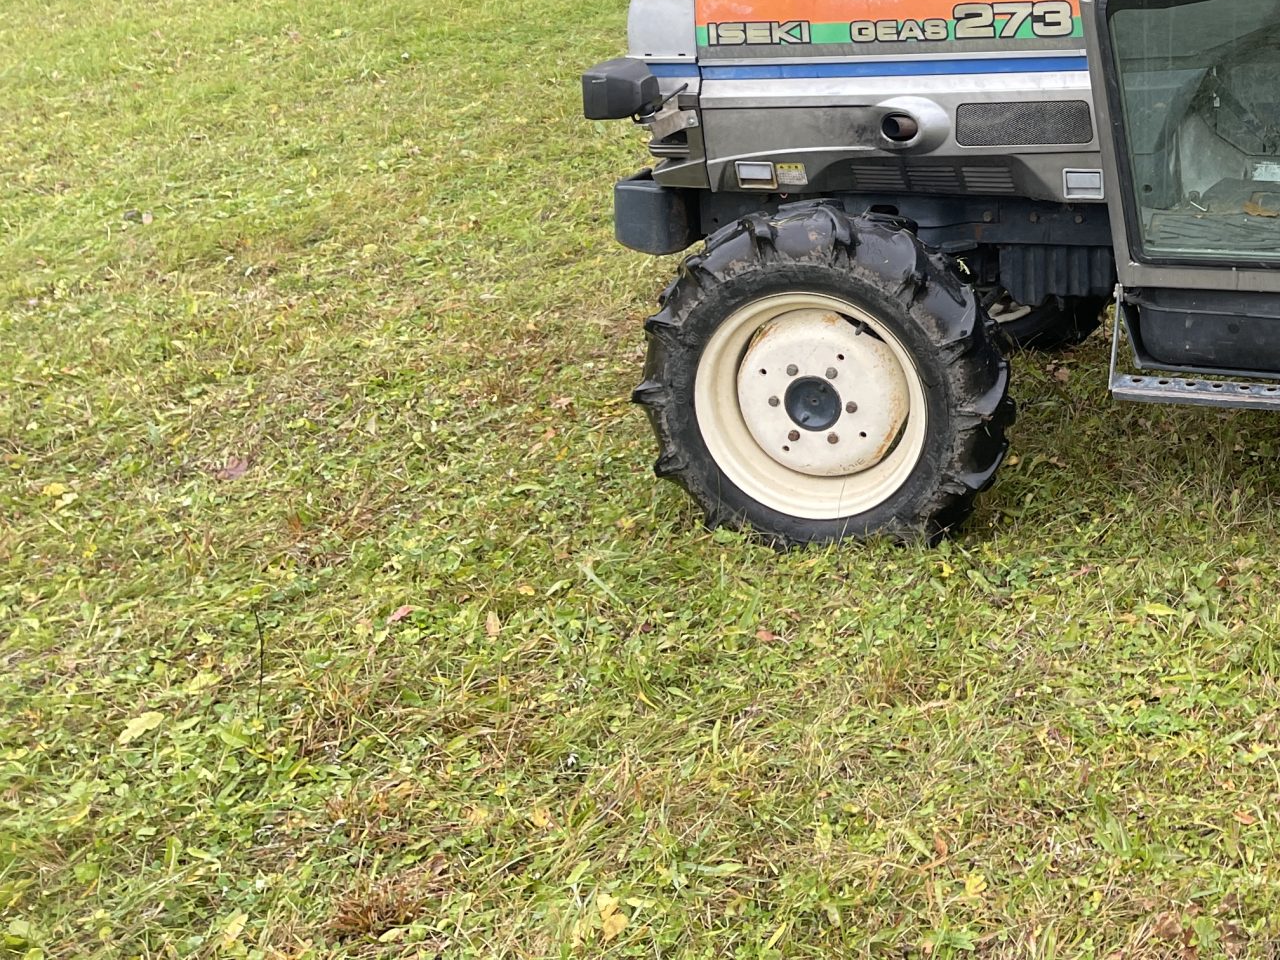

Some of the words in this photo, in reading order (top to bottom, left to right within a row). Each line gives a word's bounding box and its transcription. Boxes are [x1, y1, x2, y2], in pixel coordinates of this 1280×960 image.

[707, 20, 811, 46] ISEKI
[850, 18, 948, 43] GEAS
[953, 0, 1074, 39] 273
